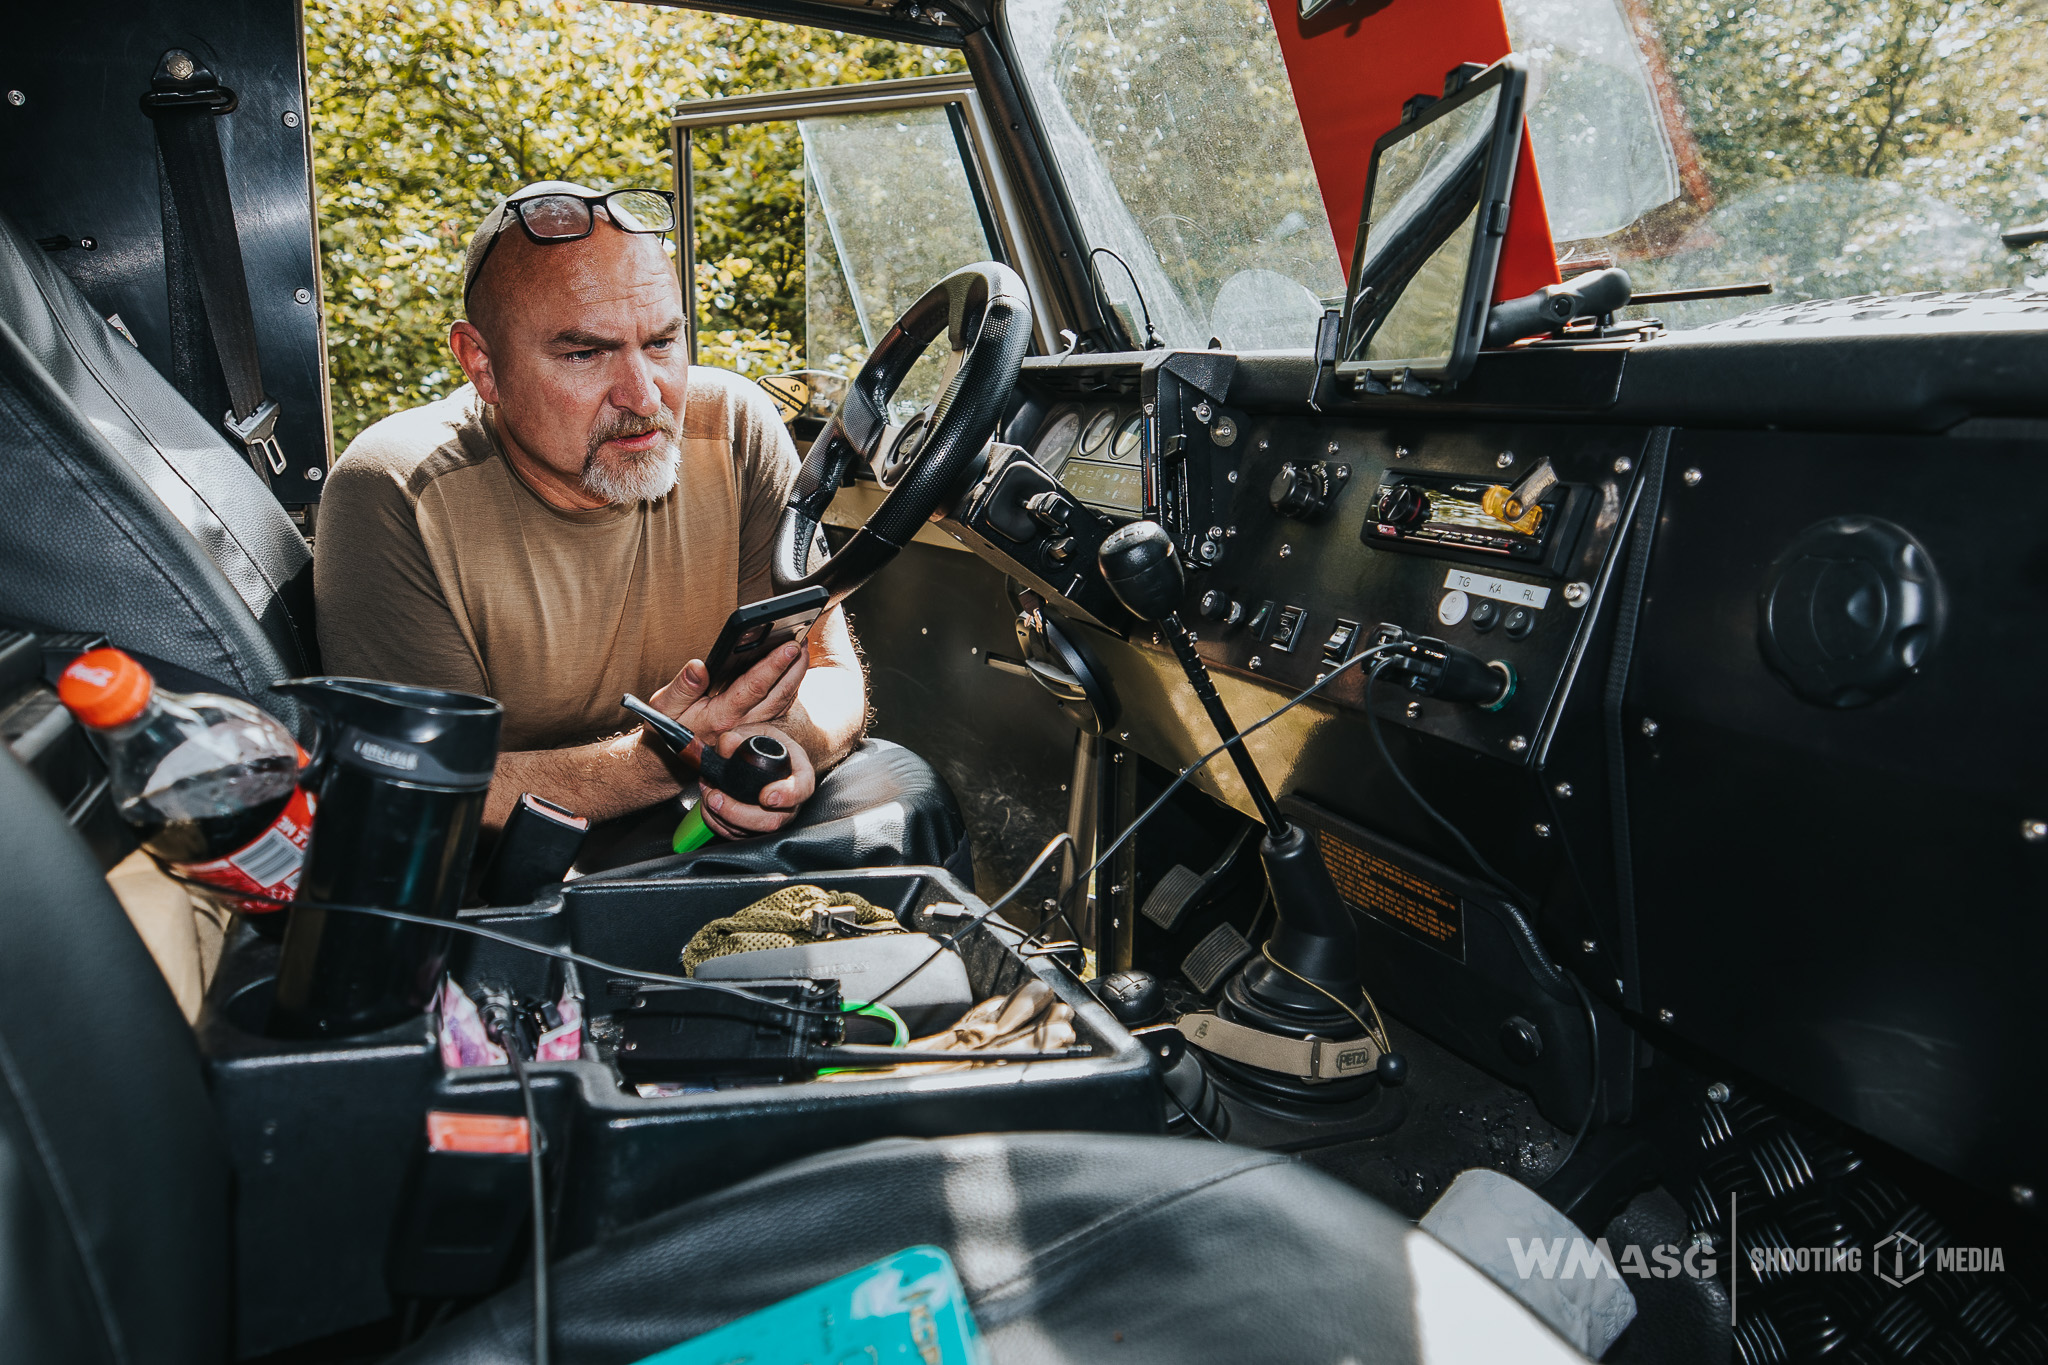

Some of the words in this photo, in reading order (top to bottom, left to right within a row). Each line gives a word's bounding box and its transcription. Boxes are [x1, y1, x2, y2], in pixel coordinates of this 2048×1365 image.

[1459, 576, 1472, 588] TG
[1488, 583, 1502, 594] KA
[1522, 590, 1535, 602] RL
[1338, 1050, 1370, 1073] PETZL
